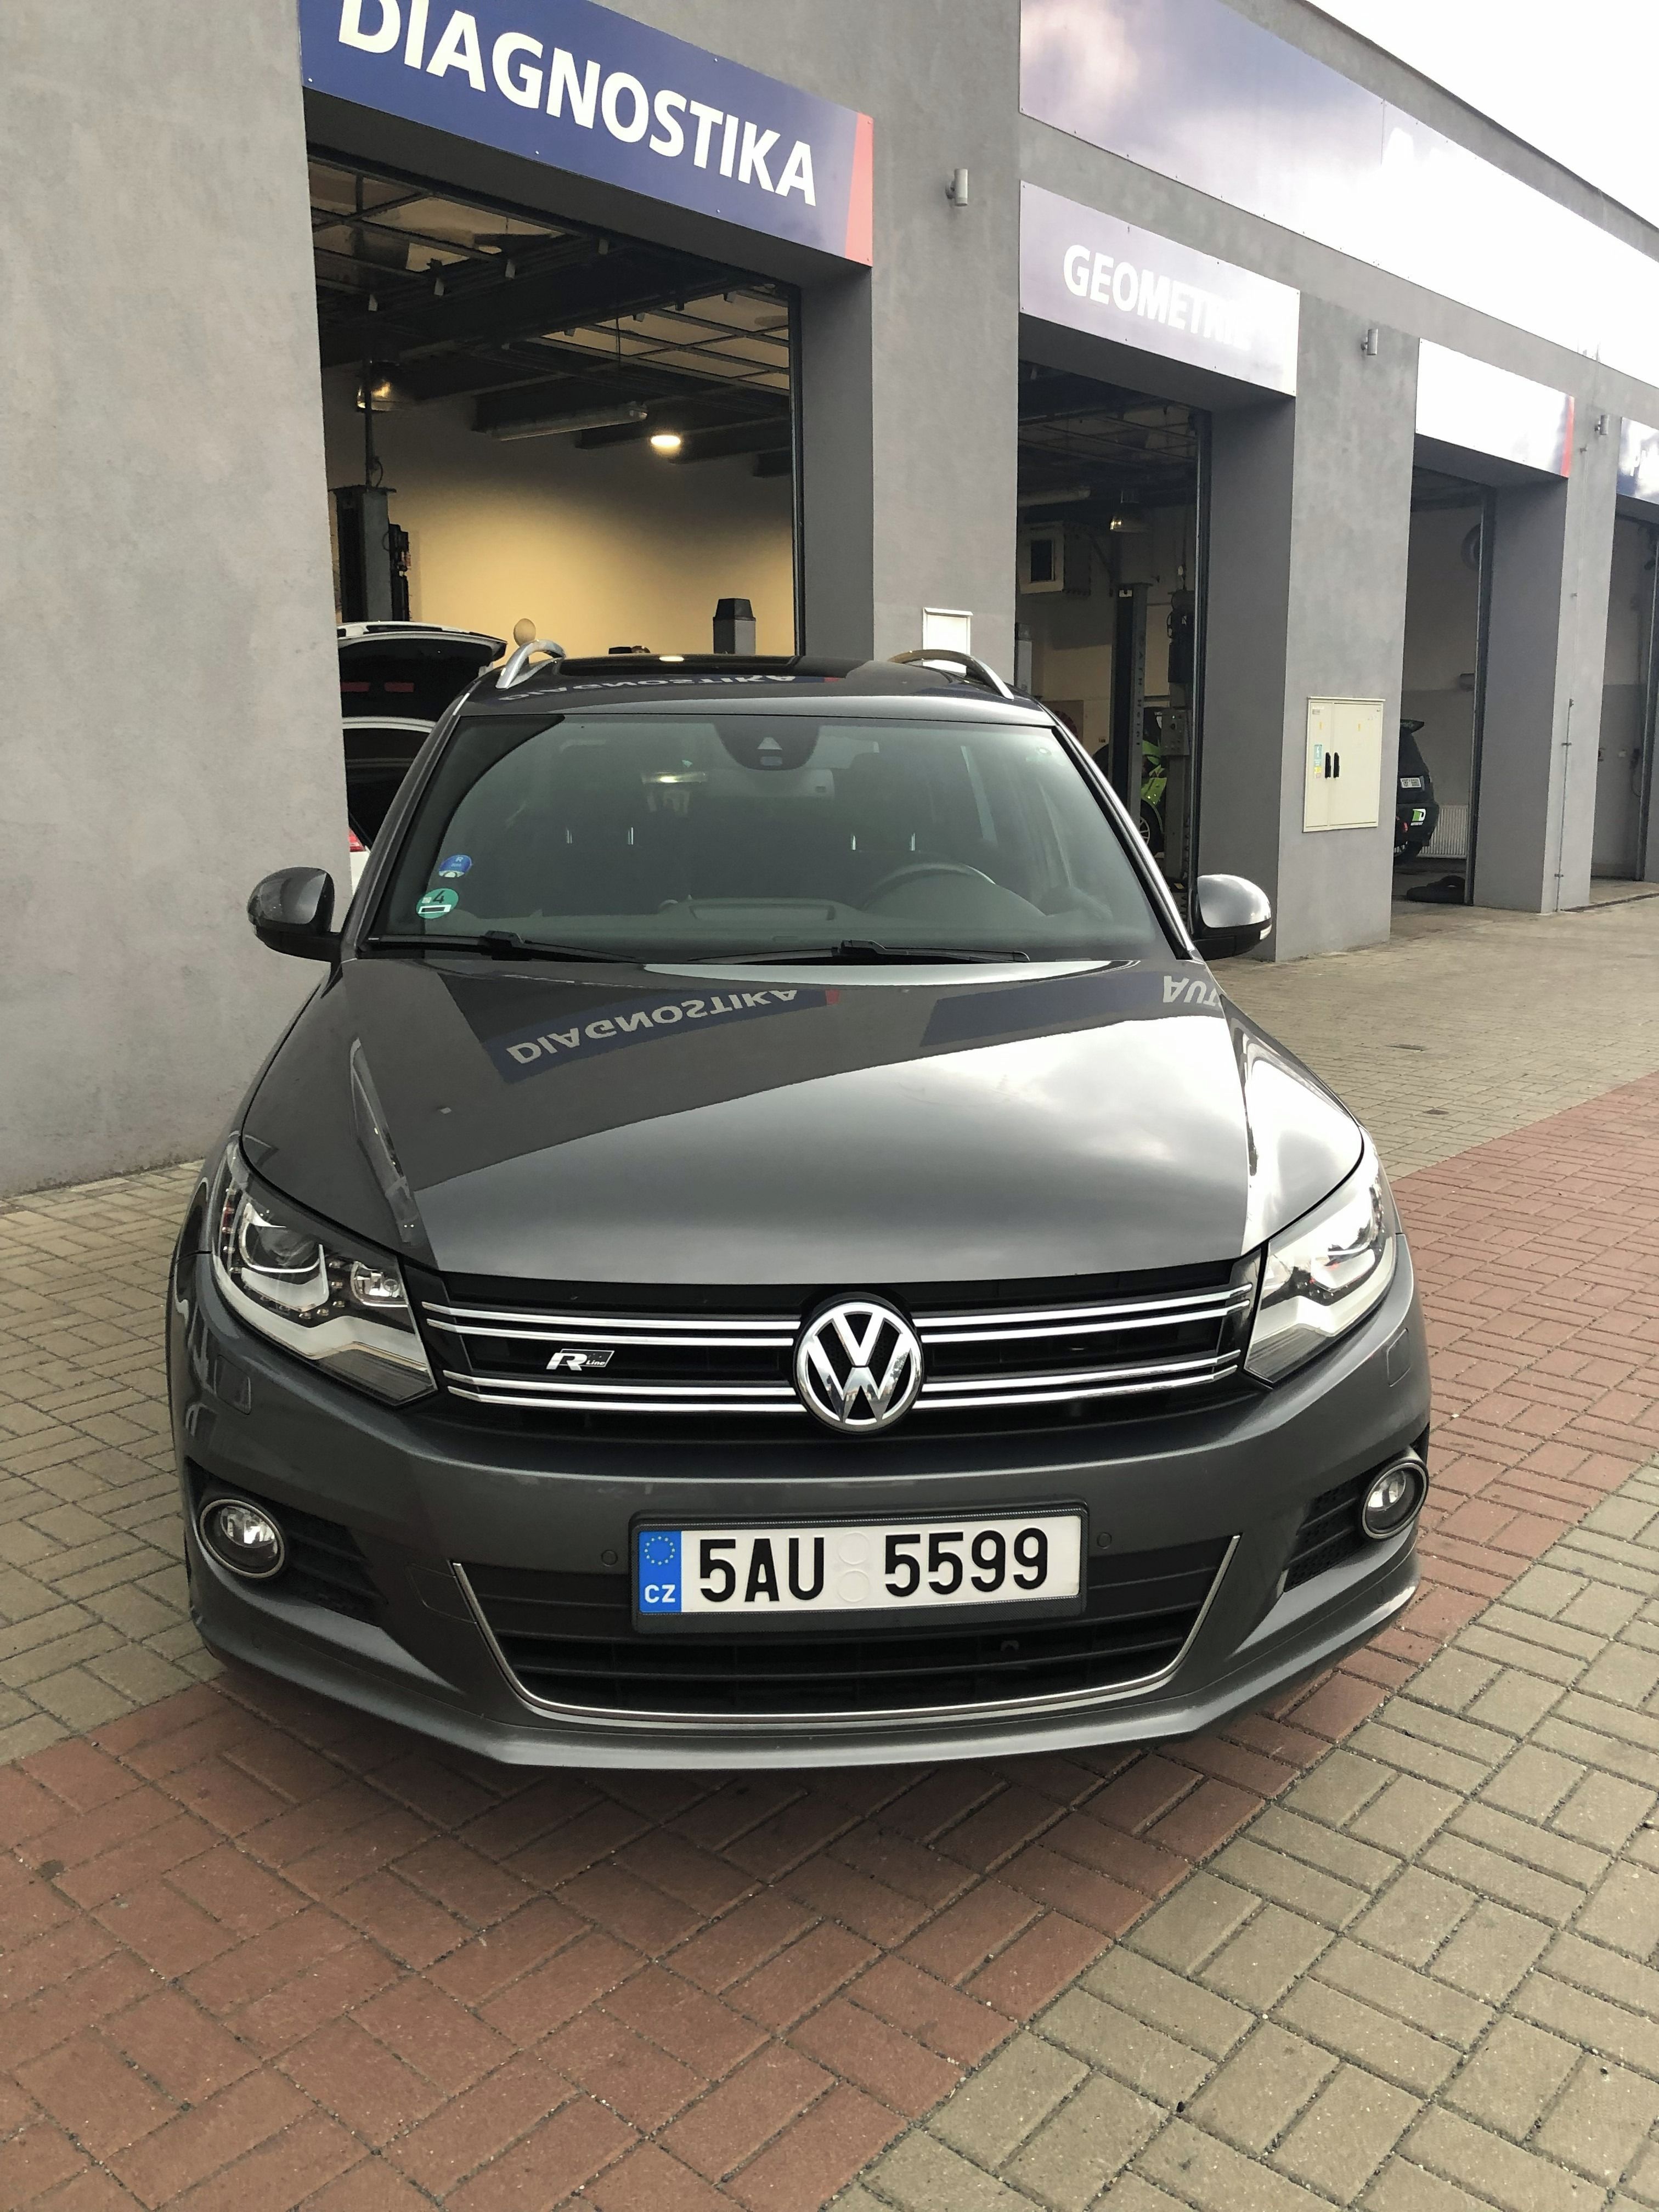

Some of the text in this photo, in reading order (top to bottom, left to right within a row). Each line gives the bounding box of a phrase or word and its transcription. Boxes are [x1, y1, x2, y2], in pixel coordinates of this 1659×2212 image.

[338, 0, 816, 206] DIAGNOSTIKA
[432, 890, 445, 904] 4
[700, 1527, 1048, 1602] 5AU 5599
[644, 1584, 676, 1603] CZ
